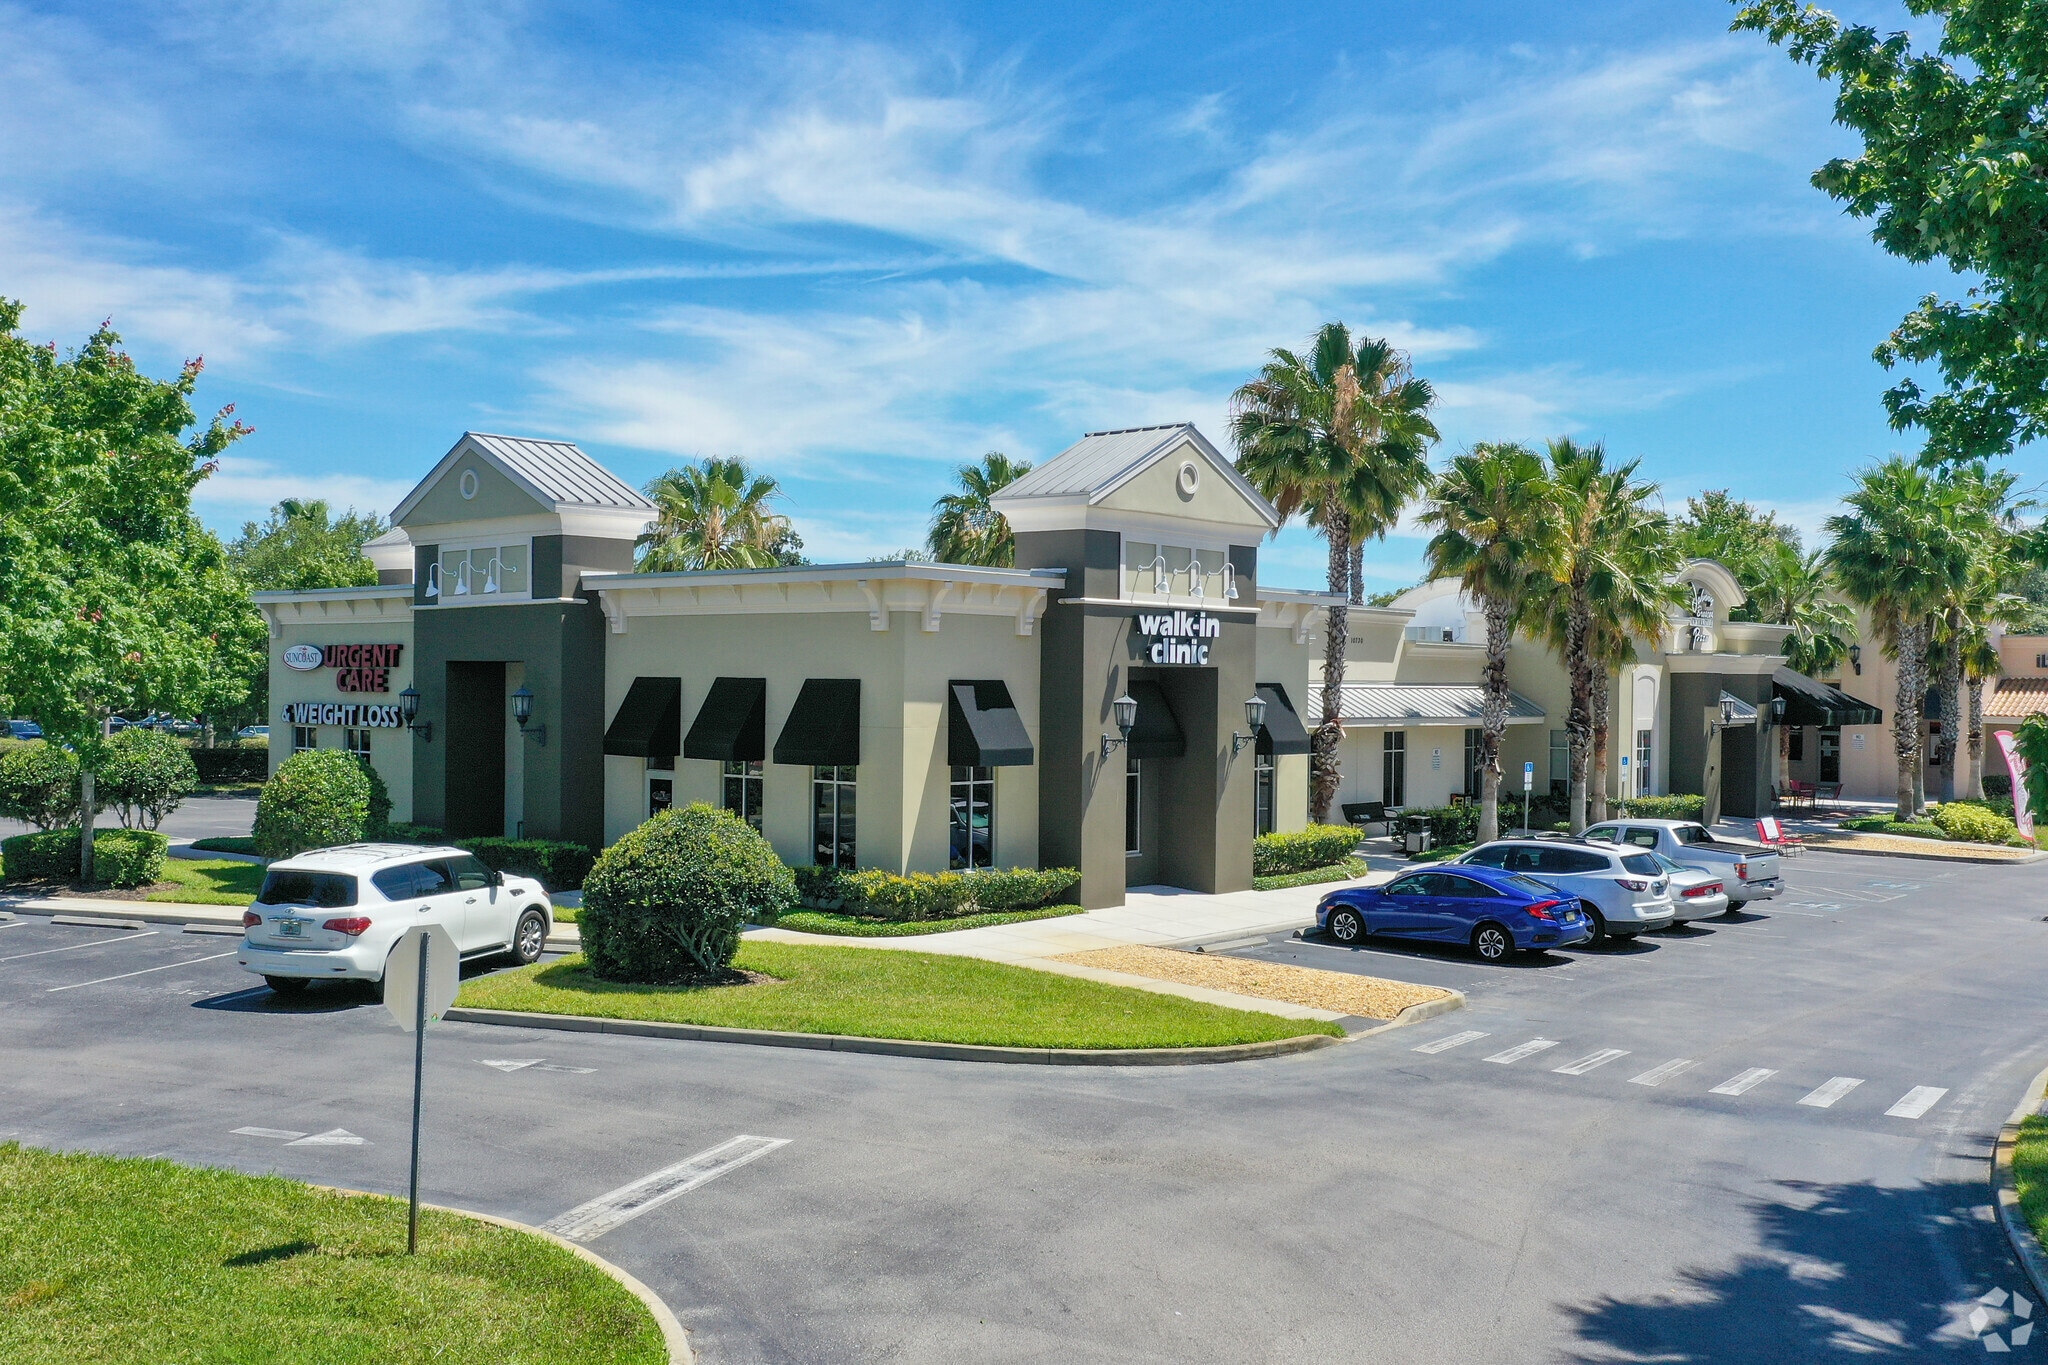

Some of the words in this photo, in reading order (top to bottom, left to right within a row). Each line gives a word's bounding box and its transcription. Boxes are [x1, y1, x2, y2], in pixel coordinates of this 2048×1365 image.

[1138, 610, 1220, 638] walk-in
[286, 651, 319, 663] SUNCOAST
[324, 644, 400, 667] URGENT
[1151, 637, 1209, 665] clinic
[336, 668, 386, 692] CARE
[281, 704, 291, 722] &
[293, 702, 356, 726] WEIGHT
[359, 705, 400, 728] LOSS
